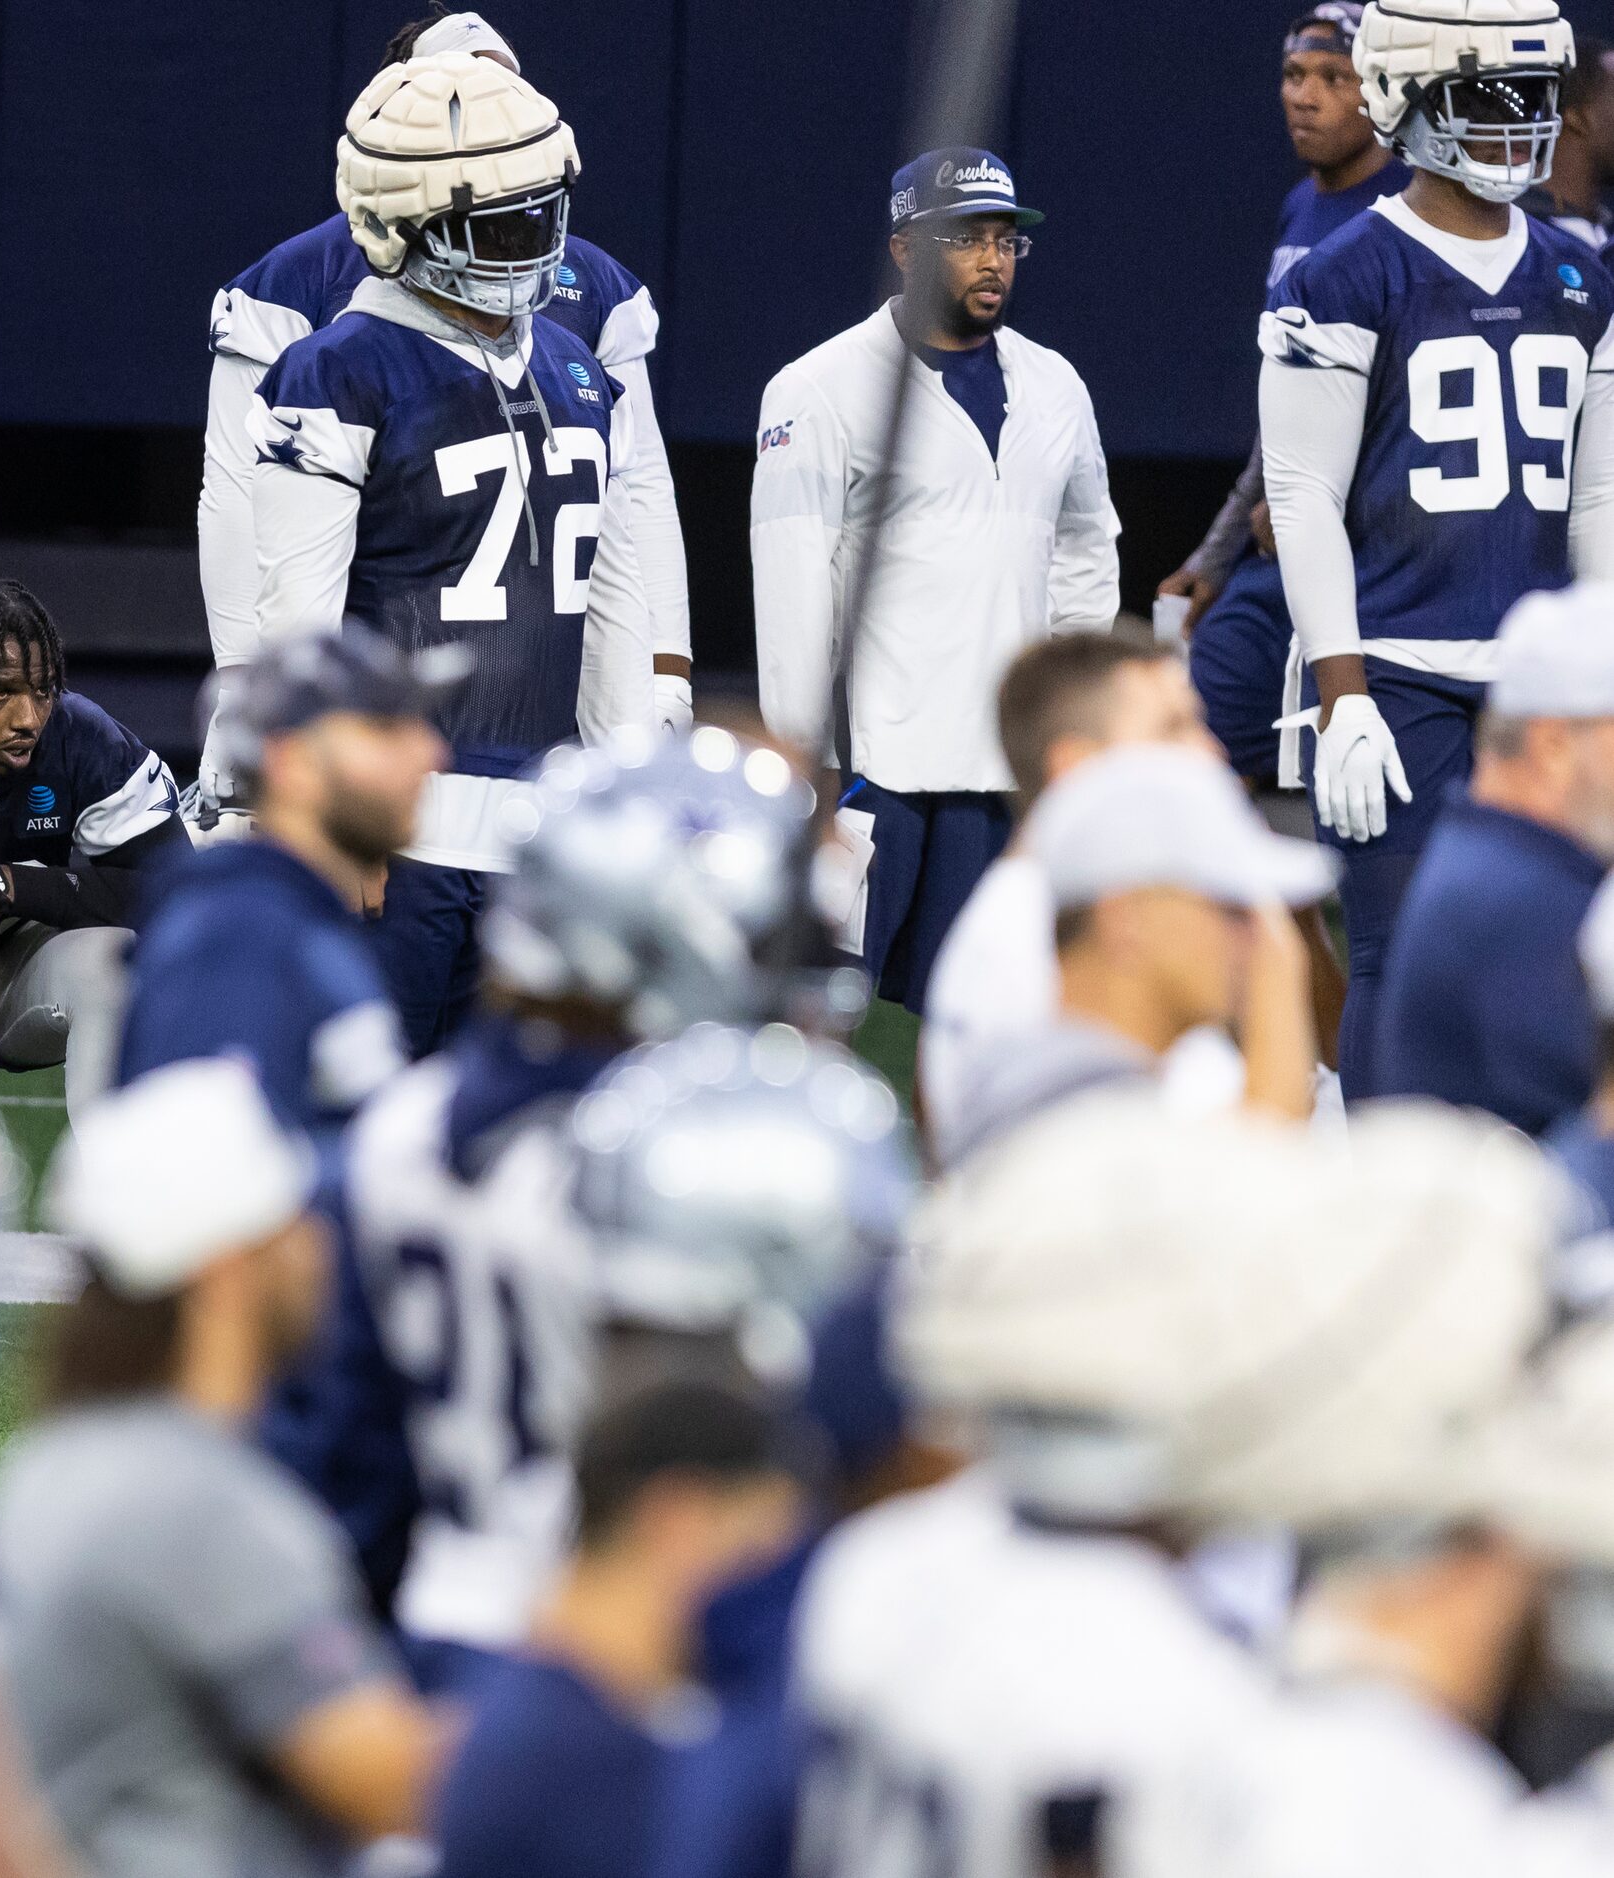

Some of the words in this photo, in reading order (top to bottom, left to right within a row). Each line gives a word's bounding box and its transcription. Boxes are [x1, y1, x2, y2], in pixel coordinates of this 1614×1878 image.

[554, 286, 583, 301] AT&T
[578, 388, 600, 402] AT&T
[1407, 334, 1589, 514] 99
[434, 427, 608, 621] 72
[26, 816, 61, 831] AT&T
